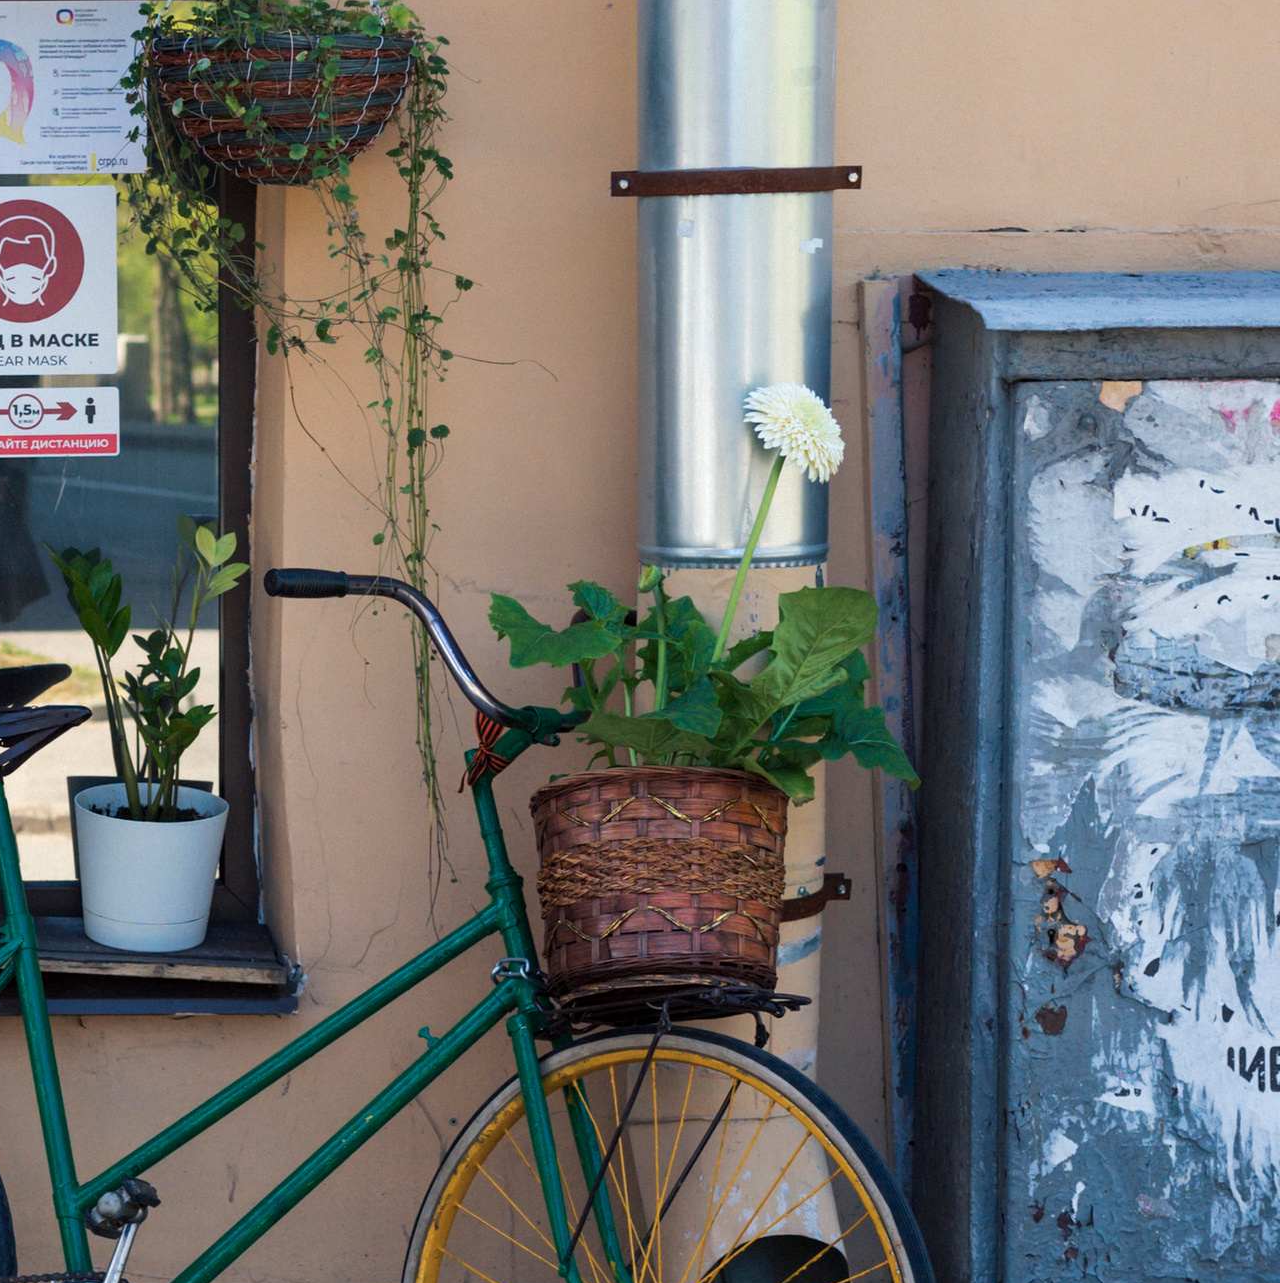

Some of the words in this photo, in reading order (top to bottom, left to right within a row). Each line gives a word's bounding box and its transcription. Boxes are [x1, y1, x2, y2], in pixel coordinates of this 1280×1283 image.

[11, 334, 23, 348] В
[29, 333, 100, 348] МАСКЕ
[27, 355, 68, 367] MASK
[30, 438, 109, 451] ДИСТАНЦИЮ
